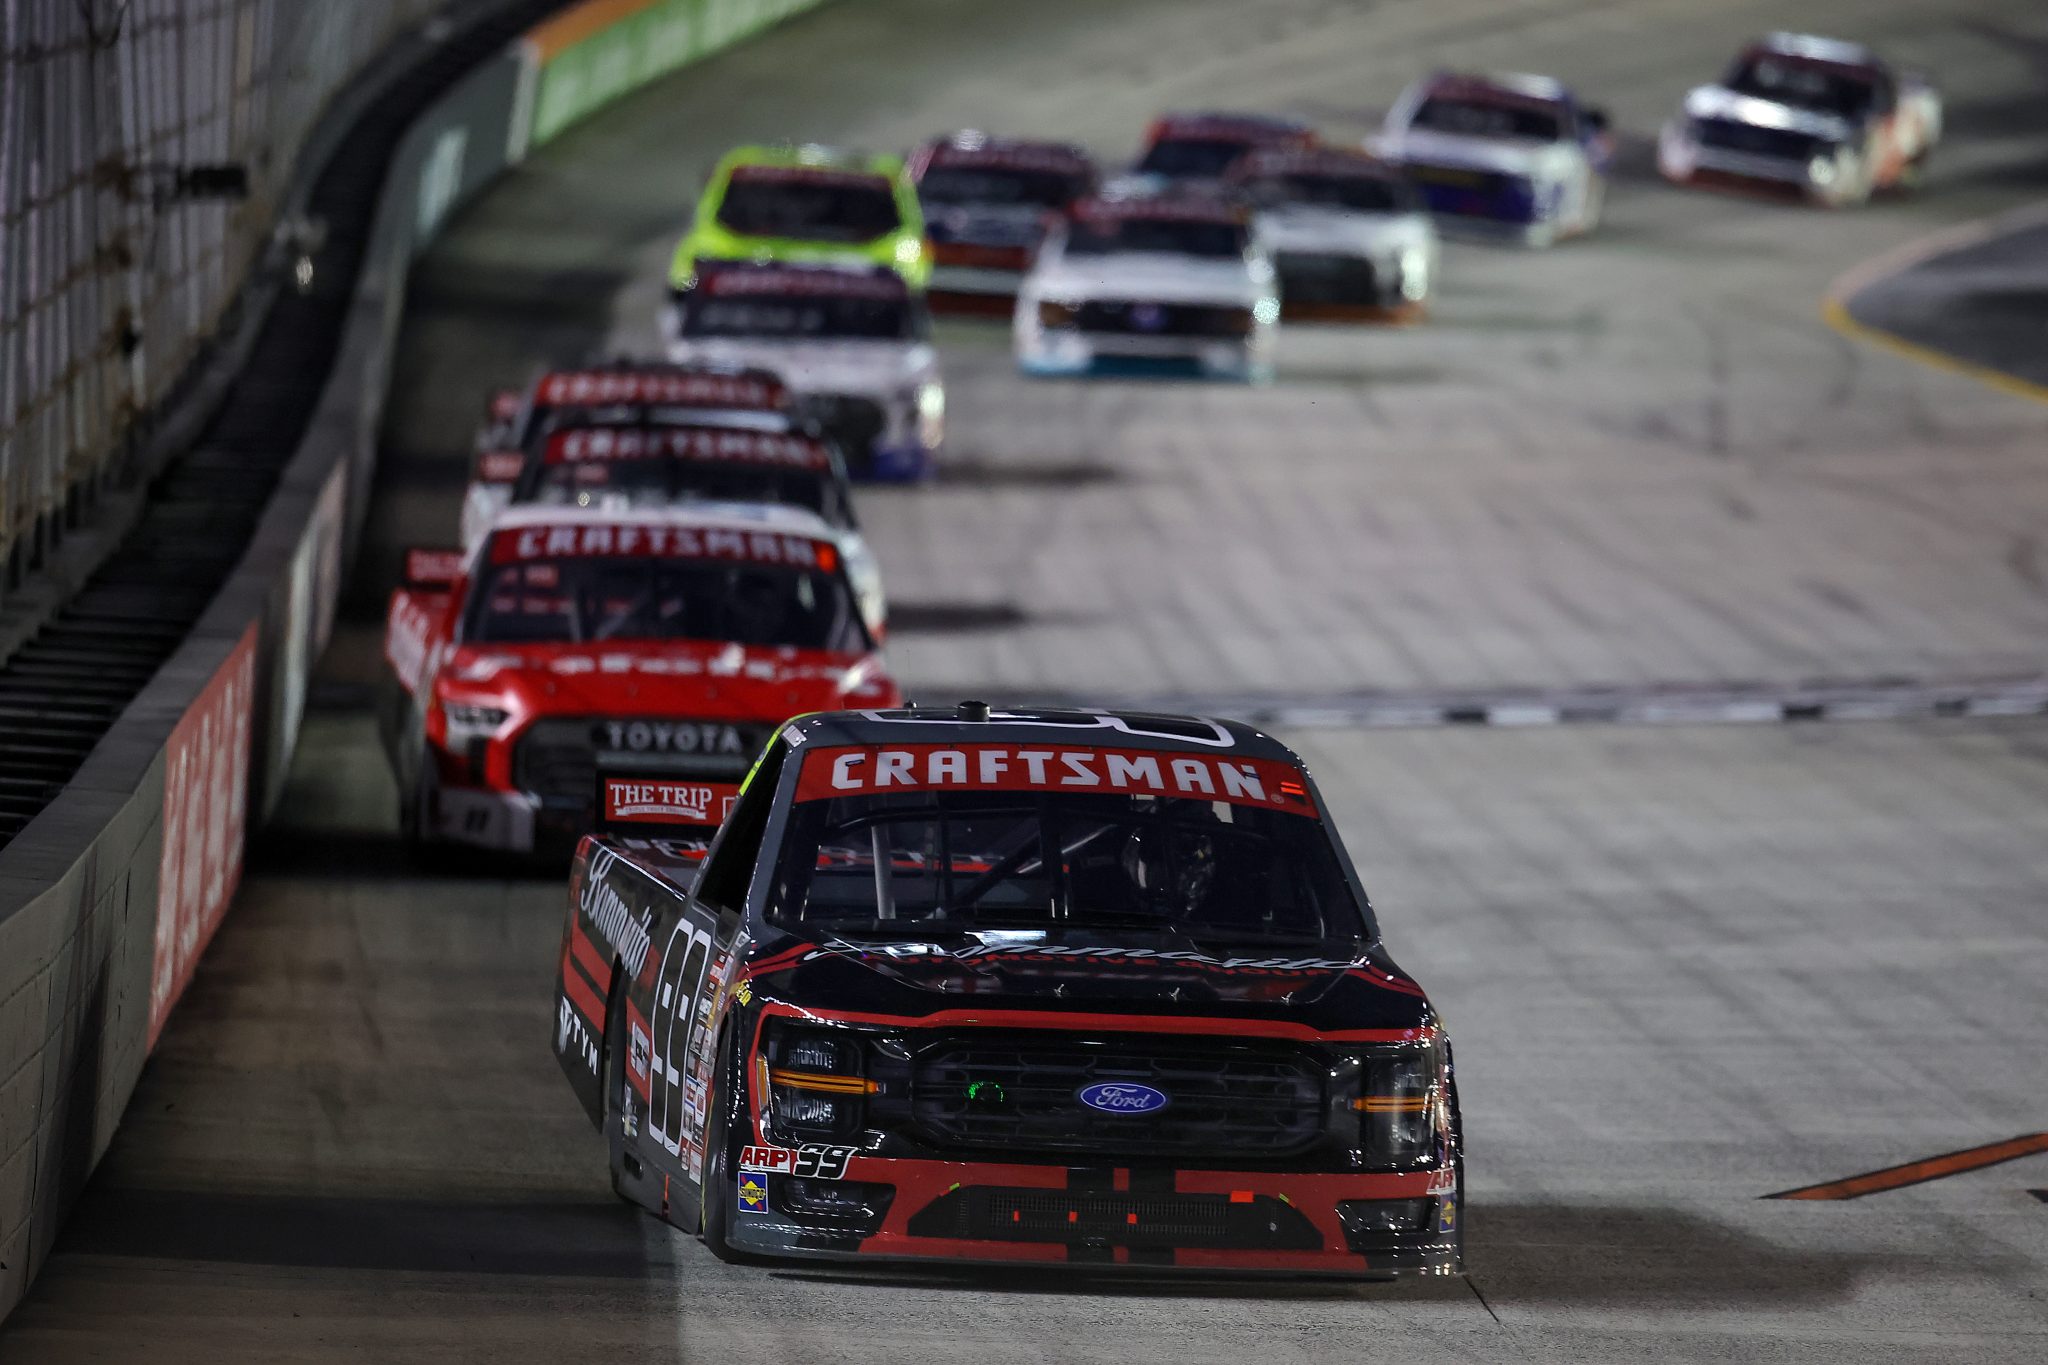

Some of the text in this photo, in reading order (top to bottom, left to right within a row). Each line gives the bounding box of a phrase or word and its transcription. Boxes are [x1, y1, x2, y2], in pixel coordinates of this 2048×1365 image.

[518, 523, 817, 566] CRAFTSMAN
[608, 721, 743, 753] TOYOTA
[831, 749, 1268, 801] CRAFTSMAN
[610, 784, 713, 811] THE TRIP
[1095, 1086, 1152, 1109] Ford
[741, 1143, 859, 1180] ARP 99
